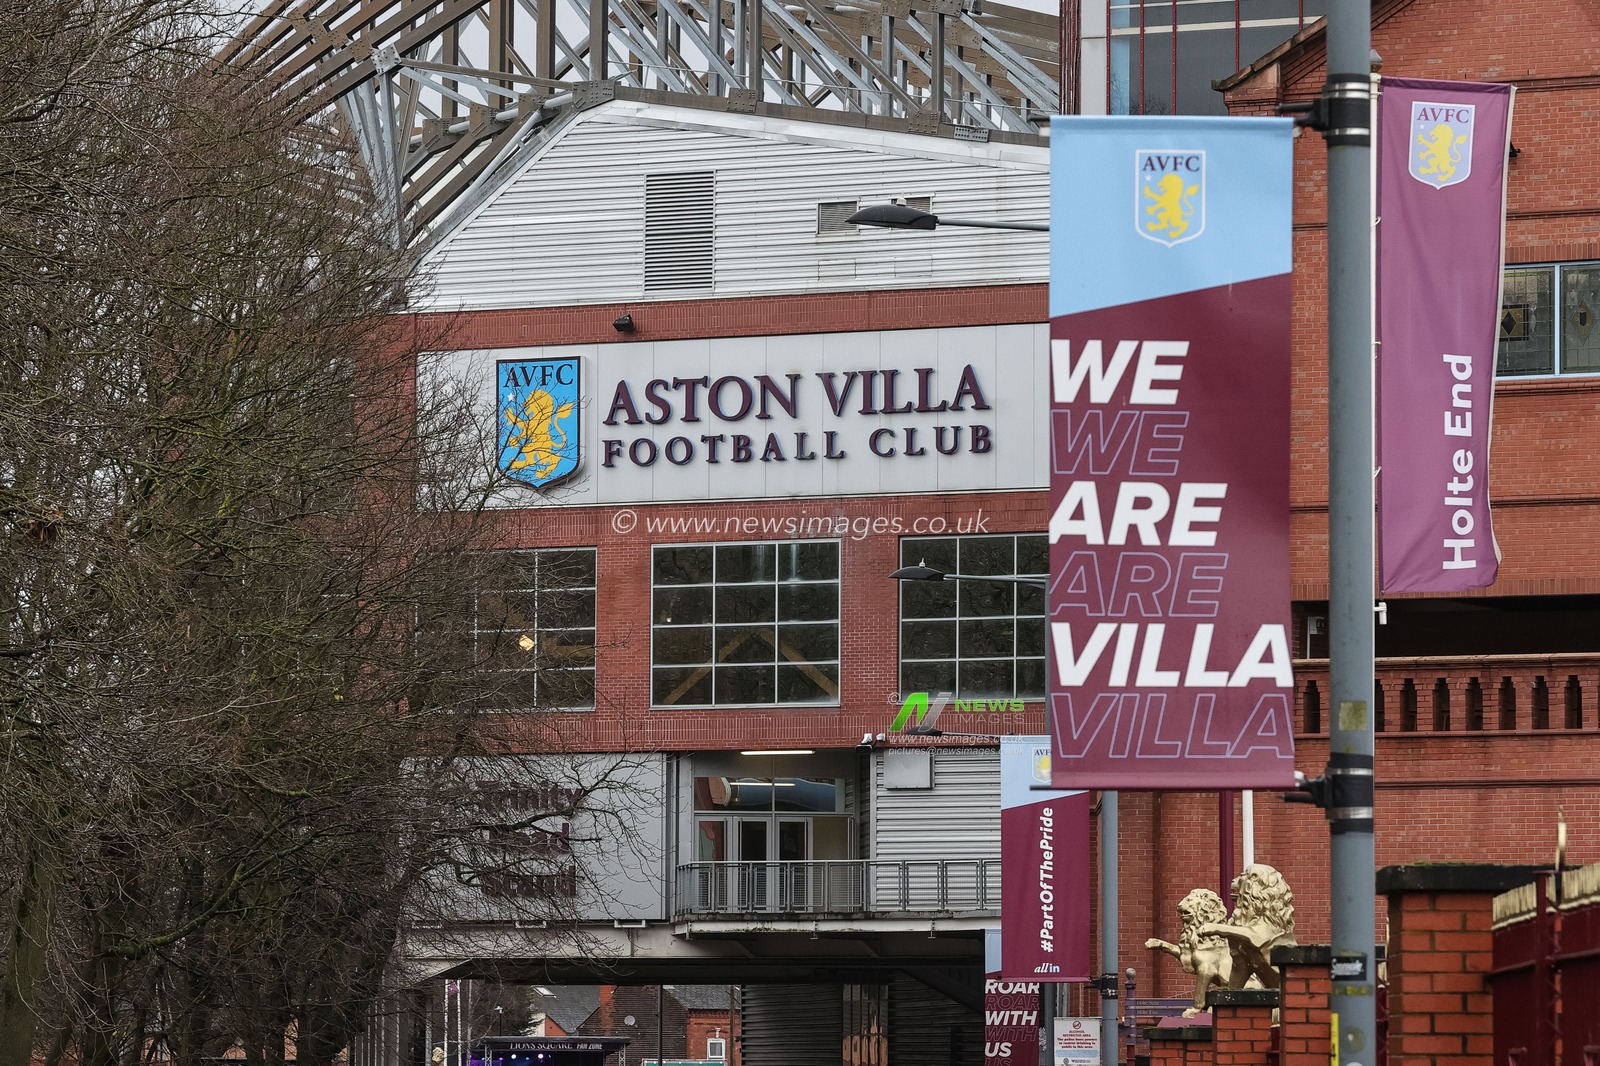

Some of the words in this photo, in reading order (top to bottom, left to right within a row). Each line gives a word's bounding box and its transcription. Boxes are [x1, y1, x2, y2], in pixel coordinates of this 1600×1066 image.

[1417, 107, 1470, 124] AVFC
[1142, 156, 1200, 172] AVFC
[503, 363, 574, 388] AVFC
[603, 373, 802, 425] ASTON
[815, 364, 992, 417] VILLA
[1050, 339, 1190, 404] WE
[1442, 353, 1473, 437] End
[602, 430, 846, 467] FOOTBALL
[869, 424, 992, 457] CLUB
[1050, 409, 1190, 475] WE
[1048, 480, 1228, 546] ARE
[1442, 448, 1477, 570] Holte
[1049, 551, 1229, 617] ARE
[1050, 621, 1294, 688] VILLA
[1050, 692, 1295, 758] VILLA
[1039, 807, 1054, 953] #PartOfThePride
[985, 979, 1040, 994] ROAR
[510, 1042, 535, 1050] LIONS
[537, 1042, 573, 1050] SQUARE
[985, 1010, 1038, 1026] WITH
[985, 1026, 1038, 1041] WITH
[984, 1042, 1012, 1058] US
